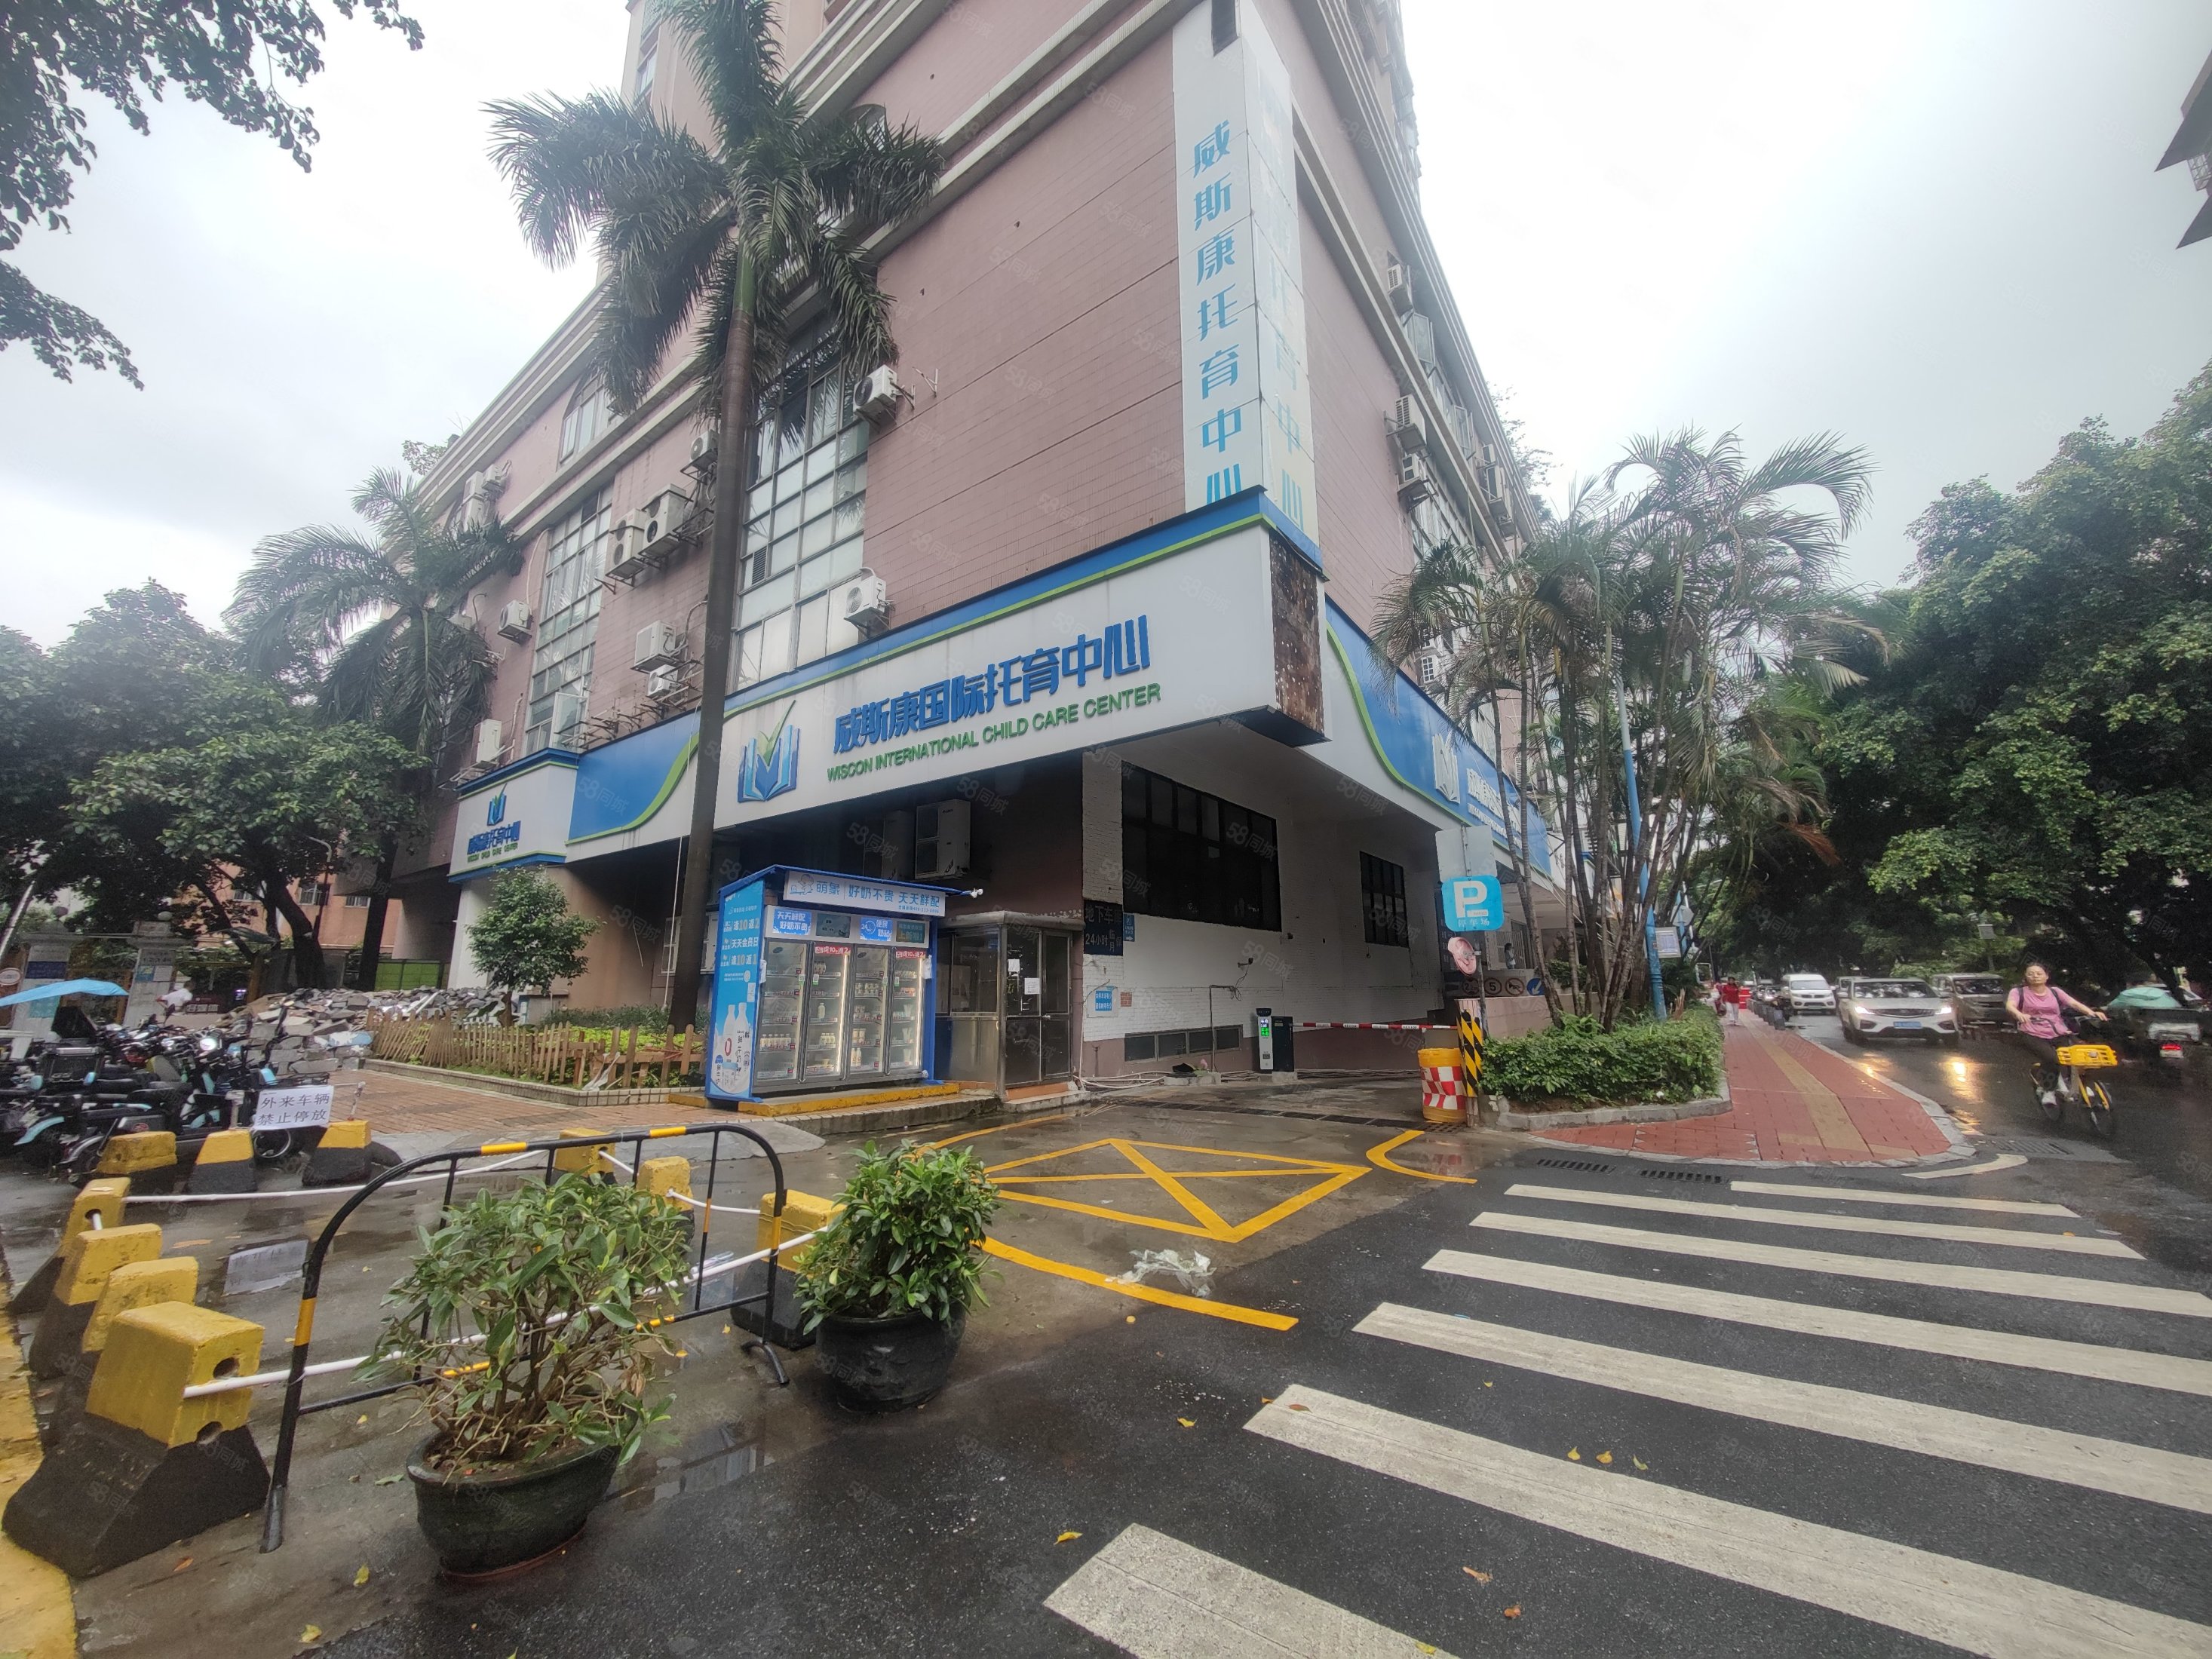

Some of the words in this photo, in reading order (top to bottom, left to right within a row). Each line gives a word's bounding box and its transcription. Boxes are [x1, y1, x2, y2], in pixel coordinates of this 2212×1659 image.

[1192, 119, 1242, 504] 威斯康托育中心
[833, 615, 1150, 753] 威斯康国际托育中心
[827, 757, 873, 781] WISCON
[875, 731, 979, 770] INTERNATIONAL
[983, 718, 1028, 744] CHILD
[1032, 704, 1078, 729] CARE
[1083, 683, 1161, 717] CENTER
[816, 881, 840, 895] 萌象
[848, 885, 894, 903] 好奶不贵
[898, 891, 940, 908] 天天鲜配
[1453, 880, 1488, 918] P
[777, 912, 805, 921] 天天鲜配
[1085, 904, 1122, 925] 地下车库
[780, 921, 808, 932] 好奶不贵
[1085, 933, 1108, 947] 24小时
[1489, 982, 1497, 991] 5
[260, 1093, 330, 1109] 外来车辆
[257, 1109, 327, 1126] 禁止停放
